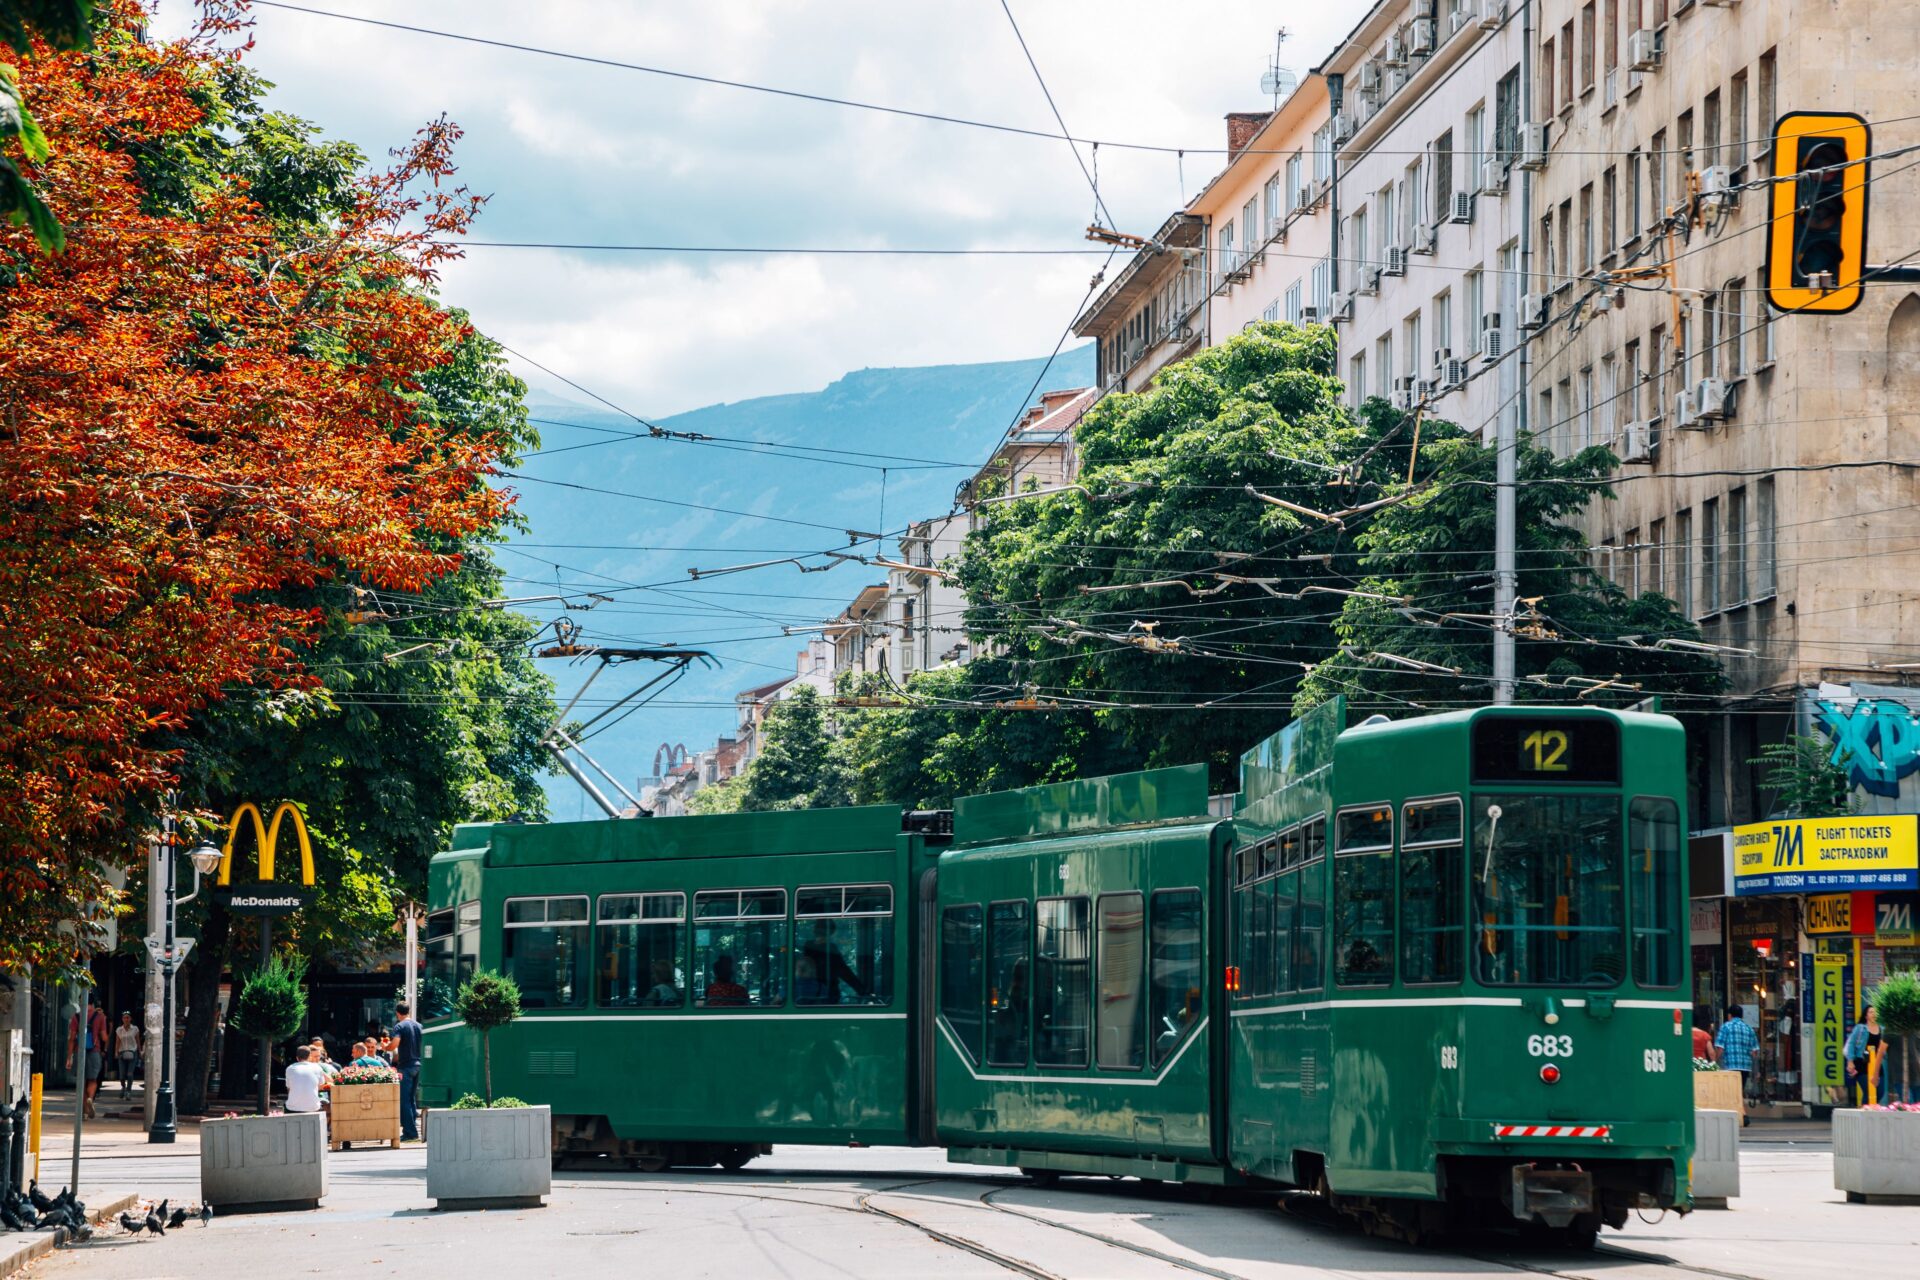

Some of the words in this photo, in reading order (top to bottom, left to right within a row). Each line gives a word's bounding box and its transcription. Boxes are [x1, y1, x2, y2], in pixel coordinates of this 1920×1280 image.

[1524, 730, 1568, 771] 12
[1816, 828, 1847, 840] FLIGHT
[1849, 826, 1892, 839] TICKETS
[1820, 847, 1888, 860] ЗАСТРАХОВКИ
[1773, 874, 1804, 887] TOURISM
[231, 896, 300, 906] McDonald's
[1809, 898, 1849, 929] CHANGE
[1823, 971, 1838, 1080] CHANGE
[1527, 1034, 1574, 1057] 683
[1441, 1046, 1458, 1069] 683
[1644, 1049, 1666, 1073] 683
